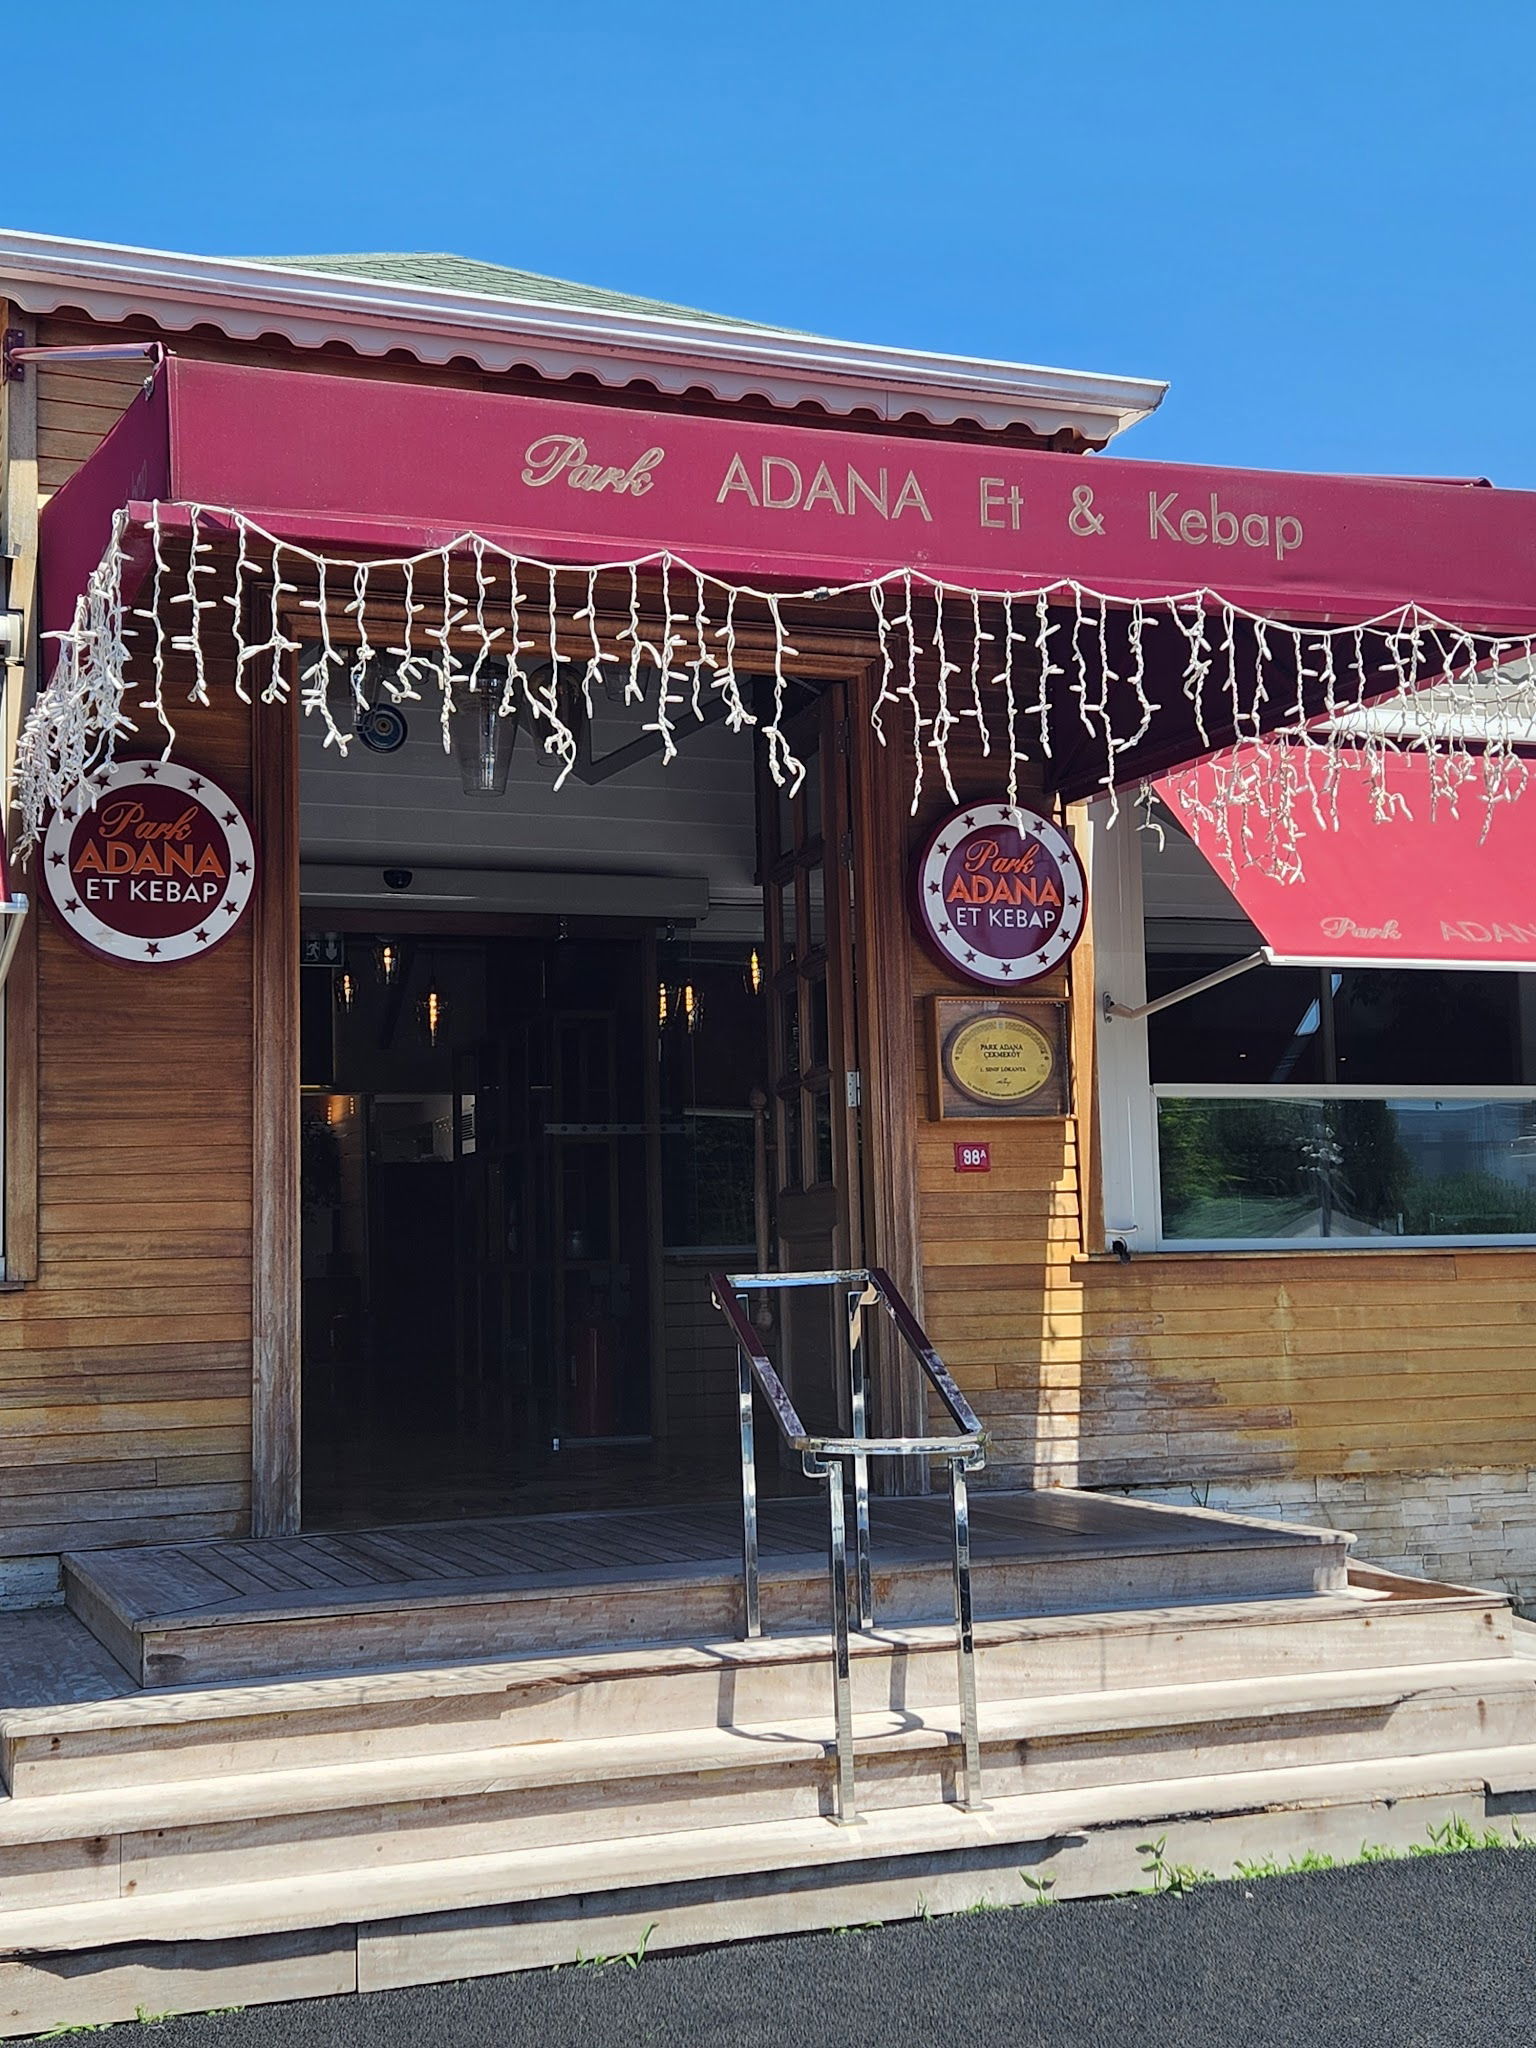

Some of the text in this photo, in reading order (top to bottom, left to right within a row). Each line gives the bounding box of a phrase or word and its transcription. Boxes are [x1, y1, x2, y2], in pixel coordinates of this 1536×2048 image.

[521, 434, 1303, 560] Park ADANA Et & Kebap
[98, 801, 199, 841] Park
[73, 838, 226, 879] ADANA
[964, 839, 1040, 875] Park
[86, 878, 218, 903] ET KEBAP
[946, 872, 1062, 907] ADANA
[956, 907, 1056, 929] ET KEBAP
[1319, 916, 1402, 940] Park
[984, 1051, 1021, 1059] ÇEKMEKÖY
[963, 1149, 986, 1166] 98A
